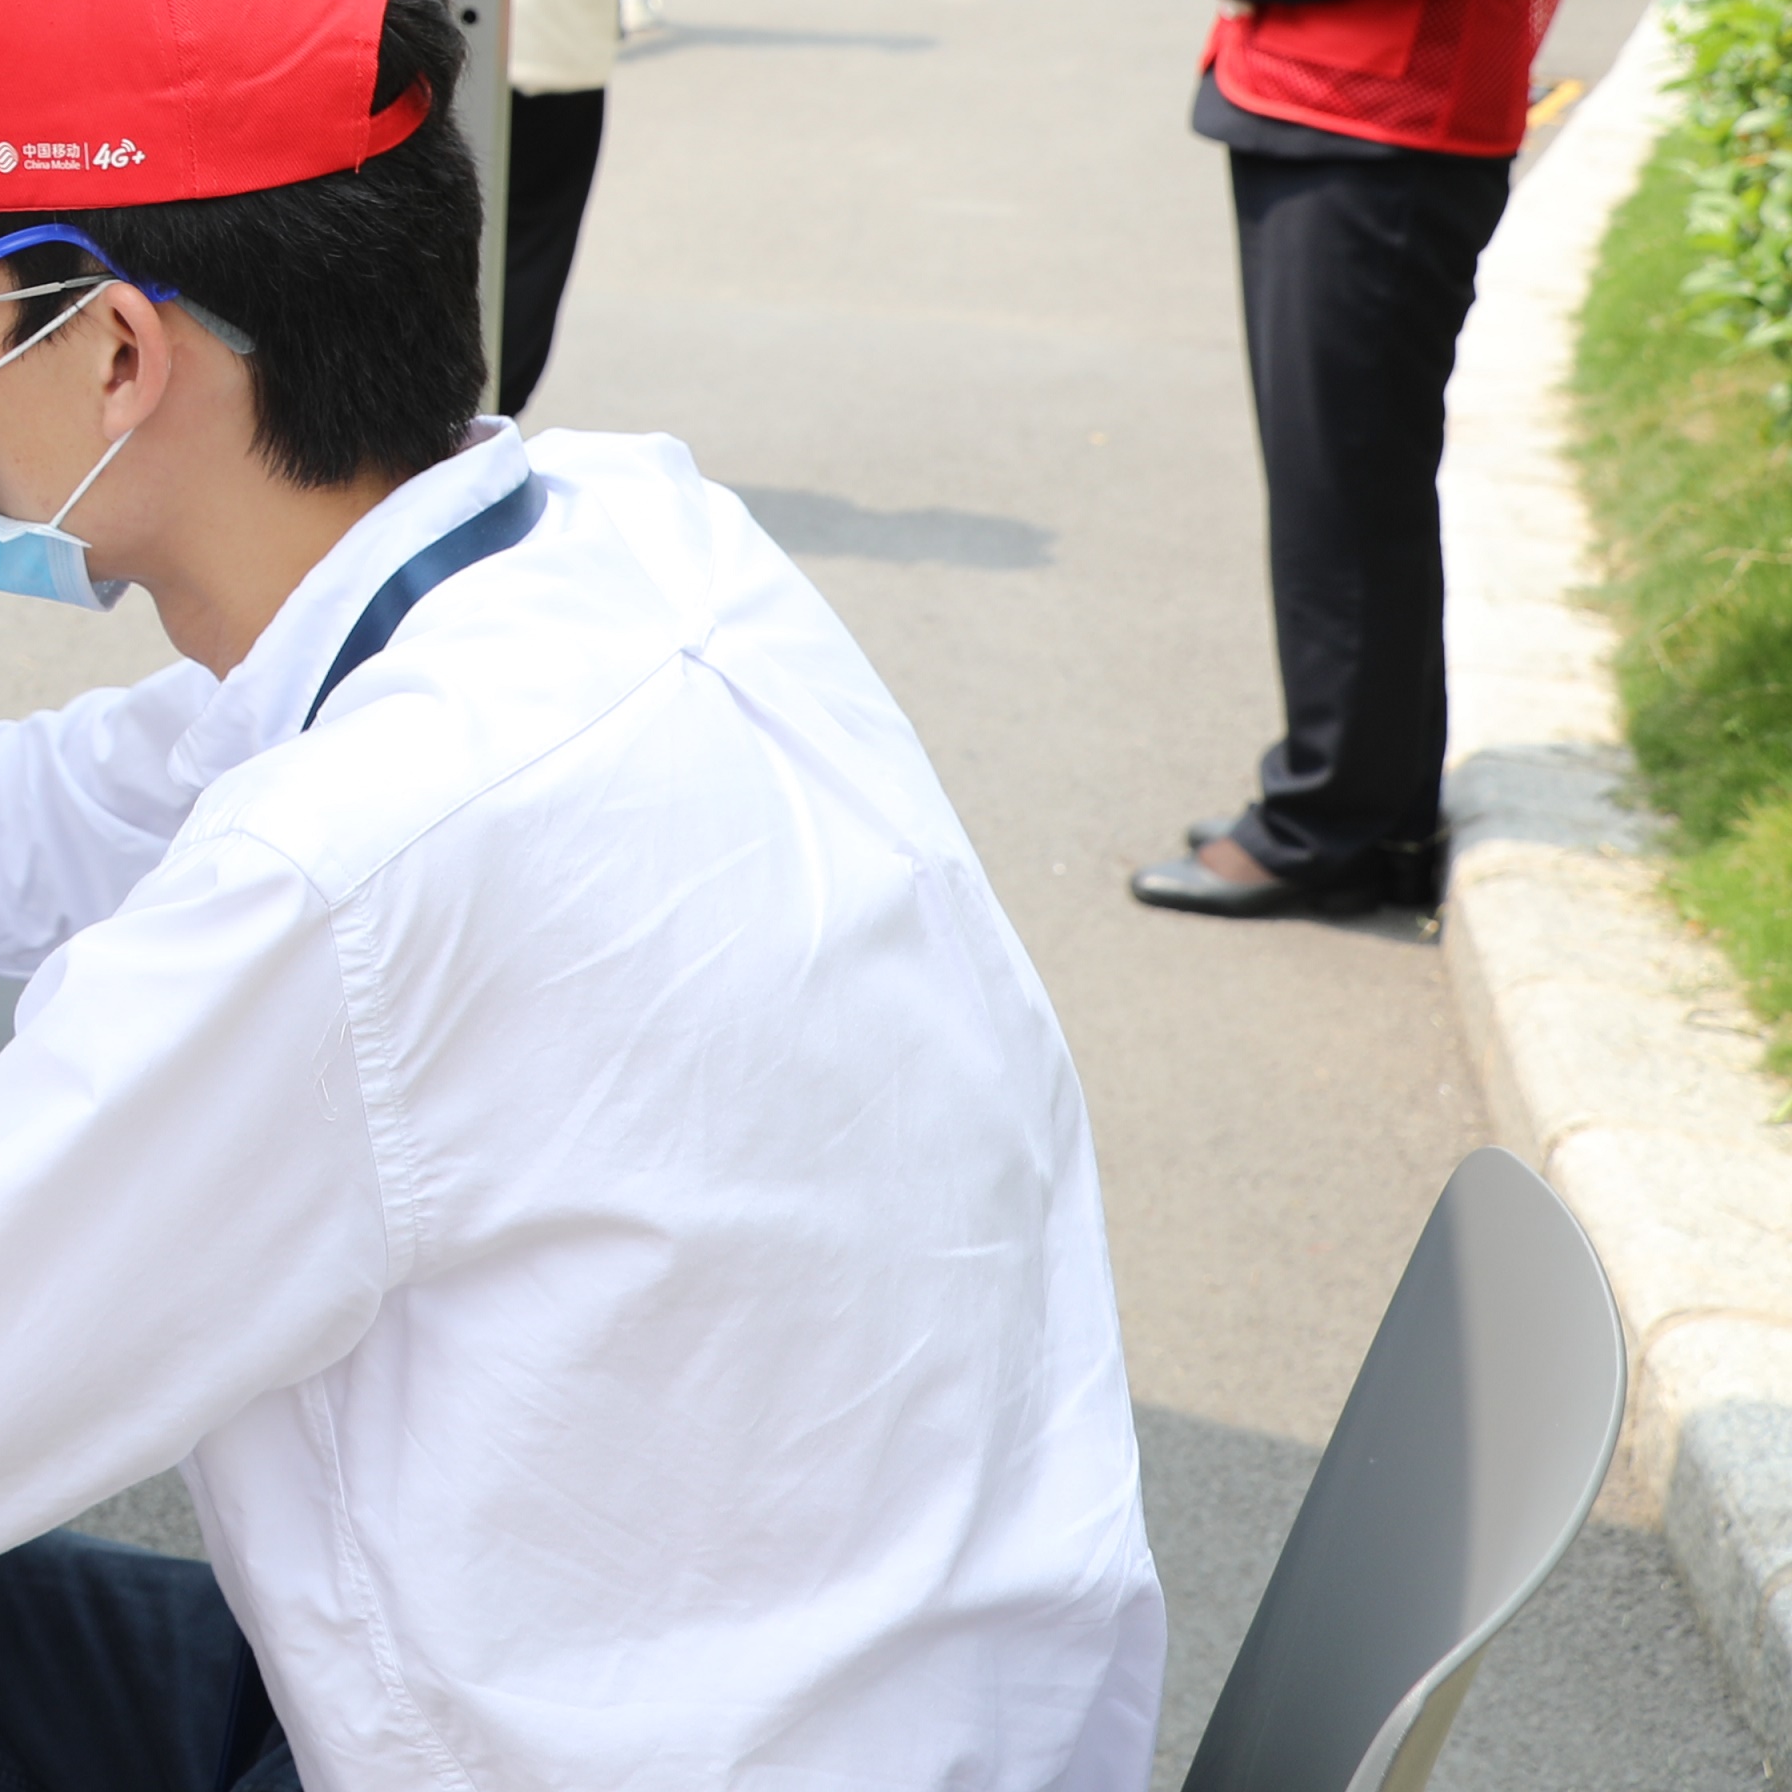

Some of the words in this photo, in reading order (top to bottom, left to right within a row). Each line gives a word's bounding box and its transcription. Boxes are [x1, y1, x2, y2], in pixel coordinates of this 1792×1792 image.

[22, 142, 81, 159] 中国移动
[92, 142, 146, 170] 4G+
[23, 159, 51, 170] China
[51, 159, 81, 170] Mobile
